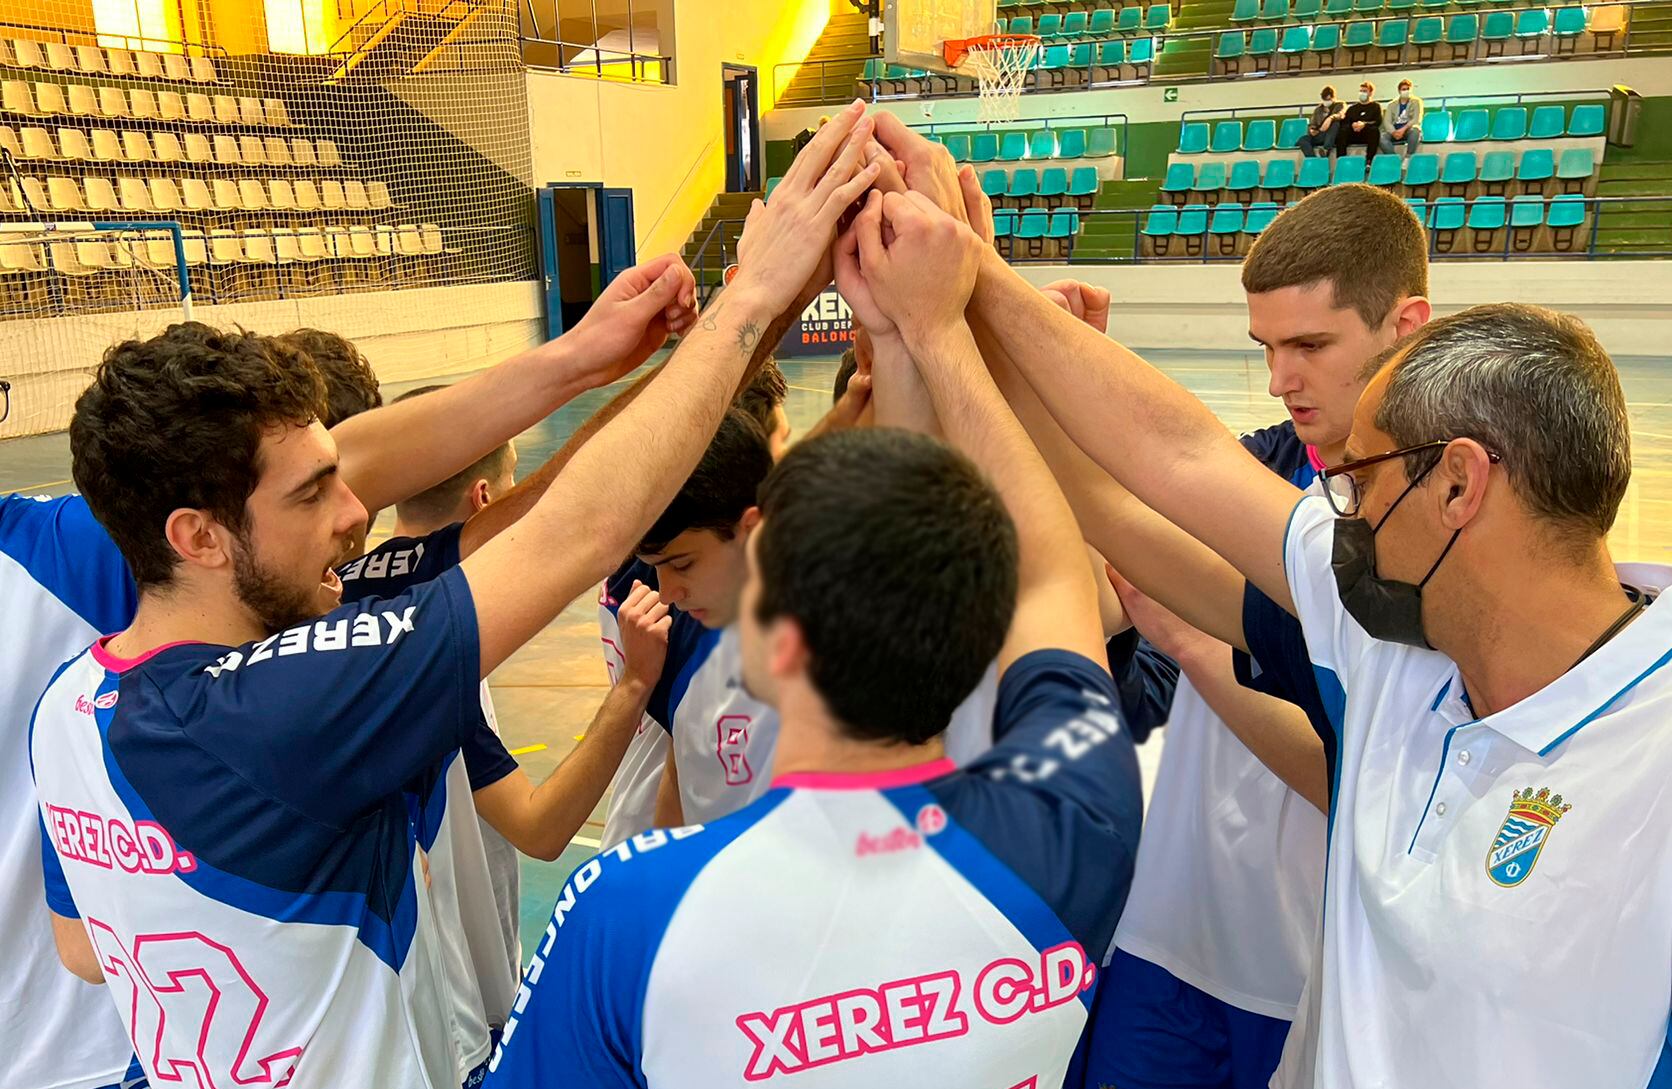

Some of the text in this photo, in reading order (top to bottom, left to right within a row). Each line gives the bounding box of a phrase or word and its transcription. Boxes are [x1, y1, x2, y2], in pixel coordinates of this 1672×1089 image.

[801, 322, 828, 331] CLUB
[247, 606, 416, 666] XEREZ
[107, 819, 198, 875] C.D.
[1493, 828, 1546, 865] XEREZ
[736, 940, 1097, 1081] XEREZ C.D.
